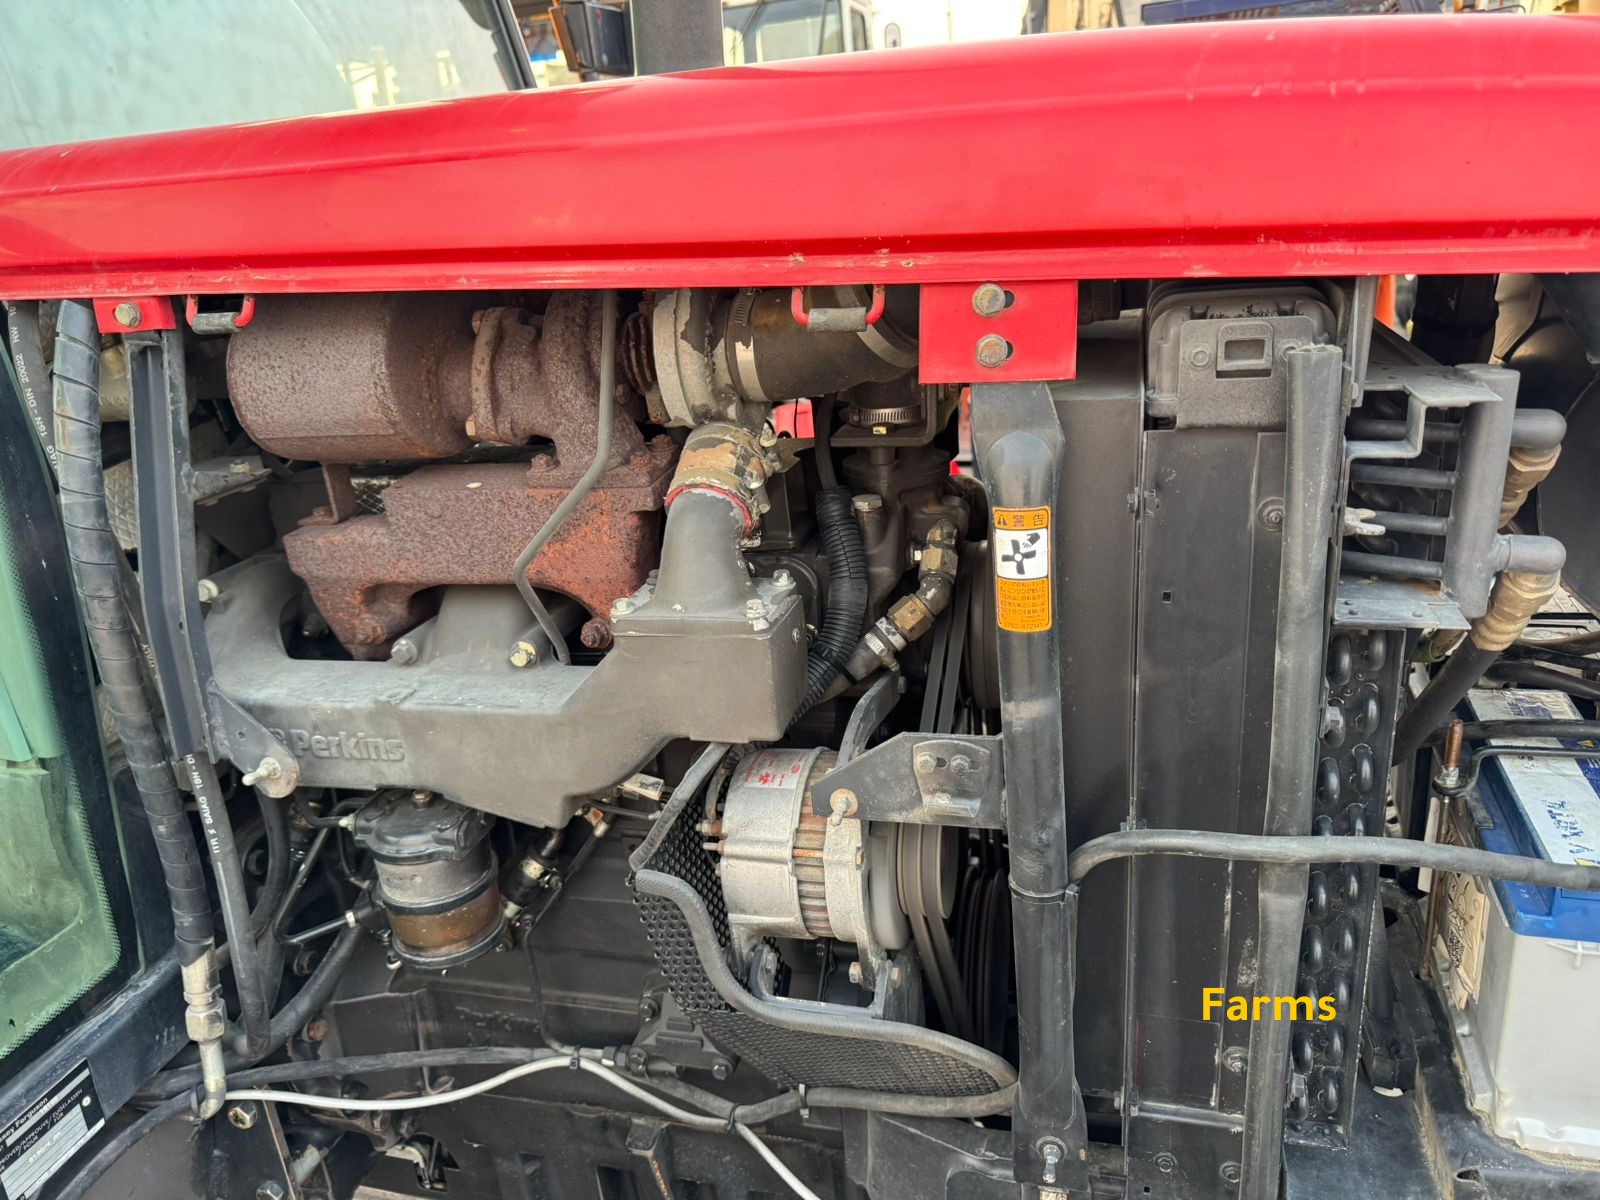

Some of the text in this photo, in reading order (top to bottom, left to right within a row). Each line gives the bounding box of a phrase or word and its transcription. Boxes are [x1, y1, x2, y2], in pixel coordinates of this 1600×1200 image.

[15, 353, 29, 384] 20022
[25, 387, 37, 407] DIN
[185, 754, 196, 765] DI
[289, 729, 405, 761] Perkins
[191, 772, 204, 790] 1SN
[199, 796, 214, 825] SAIAG
[15, 1096, 49, 1128] Ferguson
